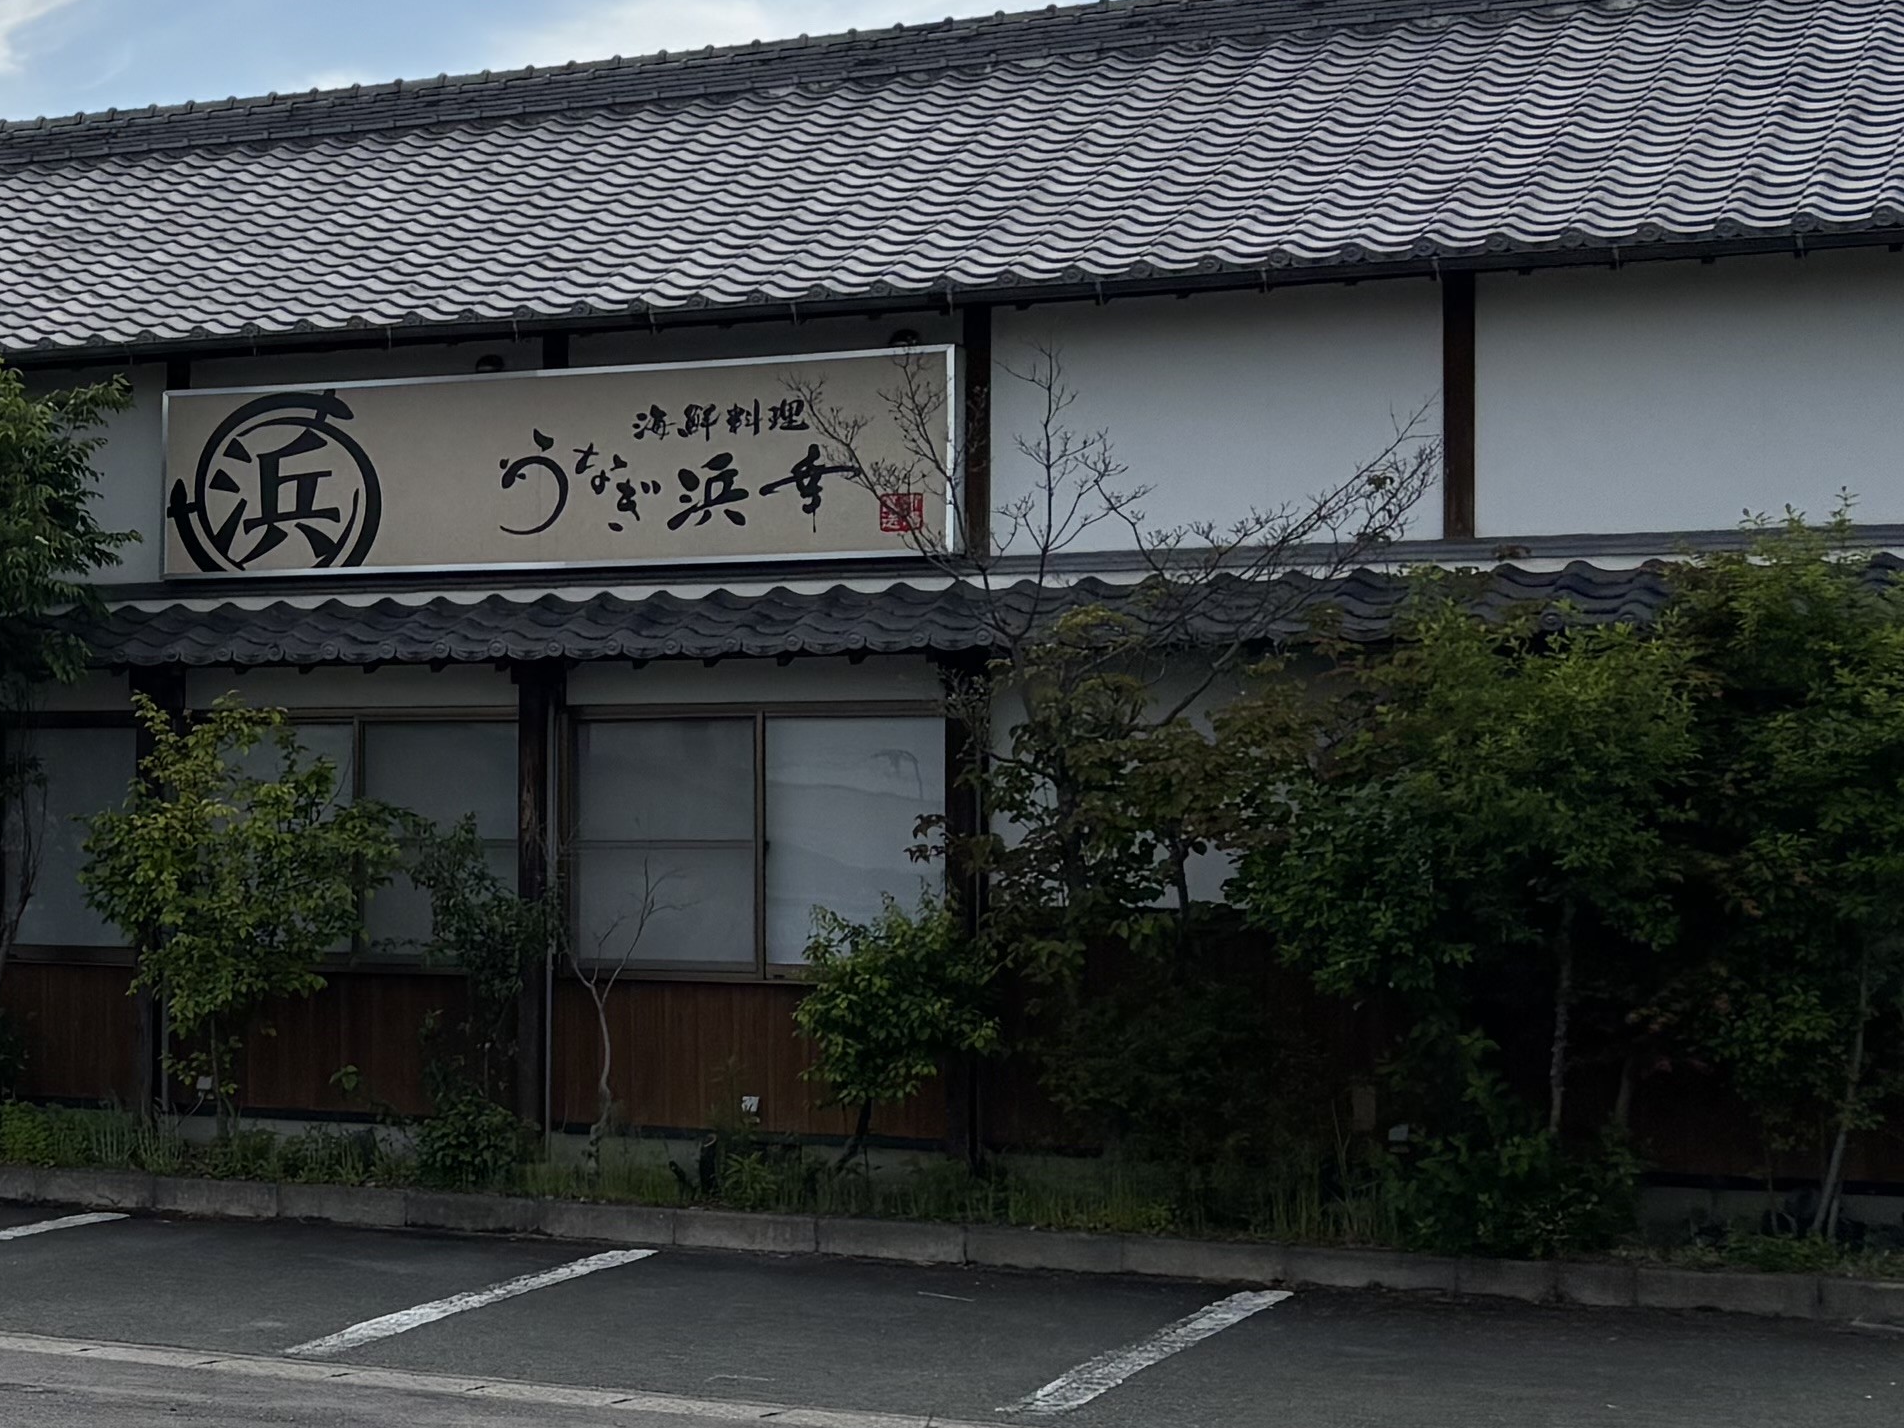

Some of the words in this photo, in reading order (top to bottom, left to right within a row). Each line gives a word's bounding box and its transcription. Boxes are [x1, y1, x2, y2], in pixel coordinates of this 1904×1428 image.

[632, 398, 810, 441] 海鮮料理
[208, 427, 340, 565] 浜
